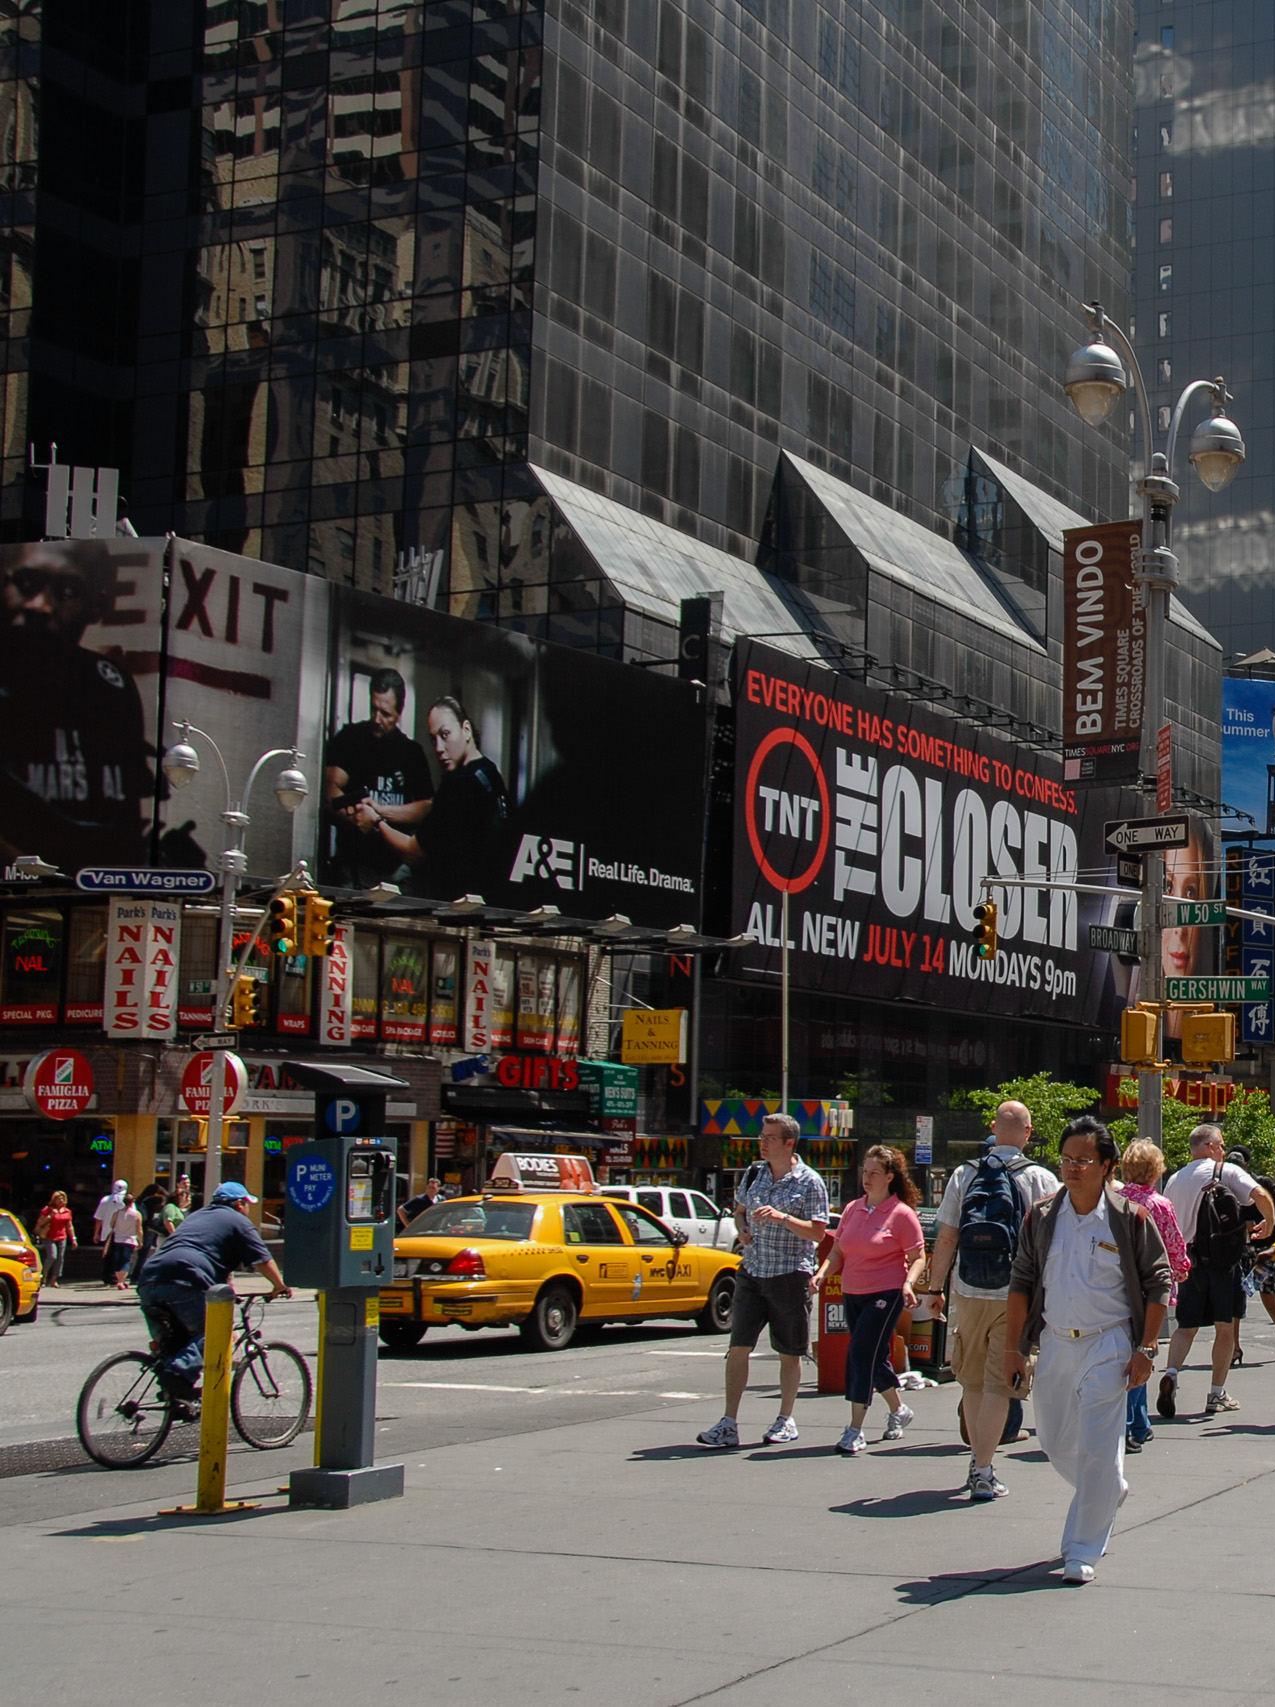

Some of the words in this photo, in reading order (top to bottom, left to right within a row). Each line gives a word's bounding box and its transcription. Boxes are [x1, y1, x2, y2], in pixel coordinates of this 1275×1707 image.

[100, 553, 289, 653] EXIT
[1075, 540, 1105, 648] VINDO
[1131, 586, 1144, 615] THE
[1132, 617, 1144, 636] OF
[1117, 629, 1130, 682] SQUARE
[1129, 638, 1144, 729] CROSSROADS
[1076, 655, 1104, 735] BEM
[1115, 682, 1128, 730] TIMES
[1226, 707, 1254, 723] This
[1222, 724, 1270, 738] ummer
[747, 669, 853, 736] EVERYONE
[857, 711, 893, 750] HAS
[896, 725, 990, 783] SOMETHING
[991, 759, 1012, 791] TO
[1014, 769, 1078, 815] CONFESS.
[27, 762, 126, 801] MARSAL
[759, 785, 820, 841] TNT
[833, 746, 878, 902] THE
[1115, 831, 1139, 844] ONE
[1154, 826, 1179, 841] WAY
[509, 833, 575, 891] A&E
[588, 857, 618, 880] Real
[620, 861, 648, 885] Life.
[649, 868, 695, 893] Drama.
[881, 764, 1079, 951] CLOSER
[91, 871, 127, 885] Van
[131, 872, 208, 889] Wagner
[117, 906, 146, 919] Park's
[151, 906, 177, 920] Park's
[1180, 906, 1191, 924] W
[1194, 904, 1210, 924] 50
[1213, 902, 1224, 914] ST
[1090, 927, 1136, 953] BROADWAY
[745, 901, 796, 950] ALL
[801, 910, 860, 960] NEW
[863, 923, 917, 969] JULY
[920, 934, 945, 974] 14
[948, 939, 1042, 990] MONDAYS
[1044, 958, 1077, 1001] 9pm
[113, 925, 143, 1030] NAILS
[147, 925, 174, 1031] NAILS
[326, 927, 348, 1041] TANNING
[1169, 979, 1246, 1000] GERSHWIN
[1250, 980, 1267, 990] WAY
[472, 961, 489, 1047] NAILS
[2, 1010, 33, 1020] SPECIAL
[36, 1010, 54, 1020] PKG.
[179, 1011, 212, 1022] TANNING
[283, 1018, 306, 1030] WRAPS
[635, 1014, 670, 1025] NAILS
[647, 1027, 657, 1037] &
[624, 1038, 679, 1050] TANNING
[498, 1055, 580, 1090] GIFTS
[37, 1085, 90, 1097] FAMIGLIA
[185, 1086, 236, 1098] FAMIIA
[47, 1098, 79, 1110] PIZZA
[336, 1099, 356, 1132] P
[90, 1139, 114, 1152] ATM
[296, 1164, 307, 1182] P
[310, 1163, 327, 1173] MUNI
[516, 1157, 559, 1173] BODIES
[310, 1172, 332, 1182] METER
[303, 1184, 318, 1192] PAY
